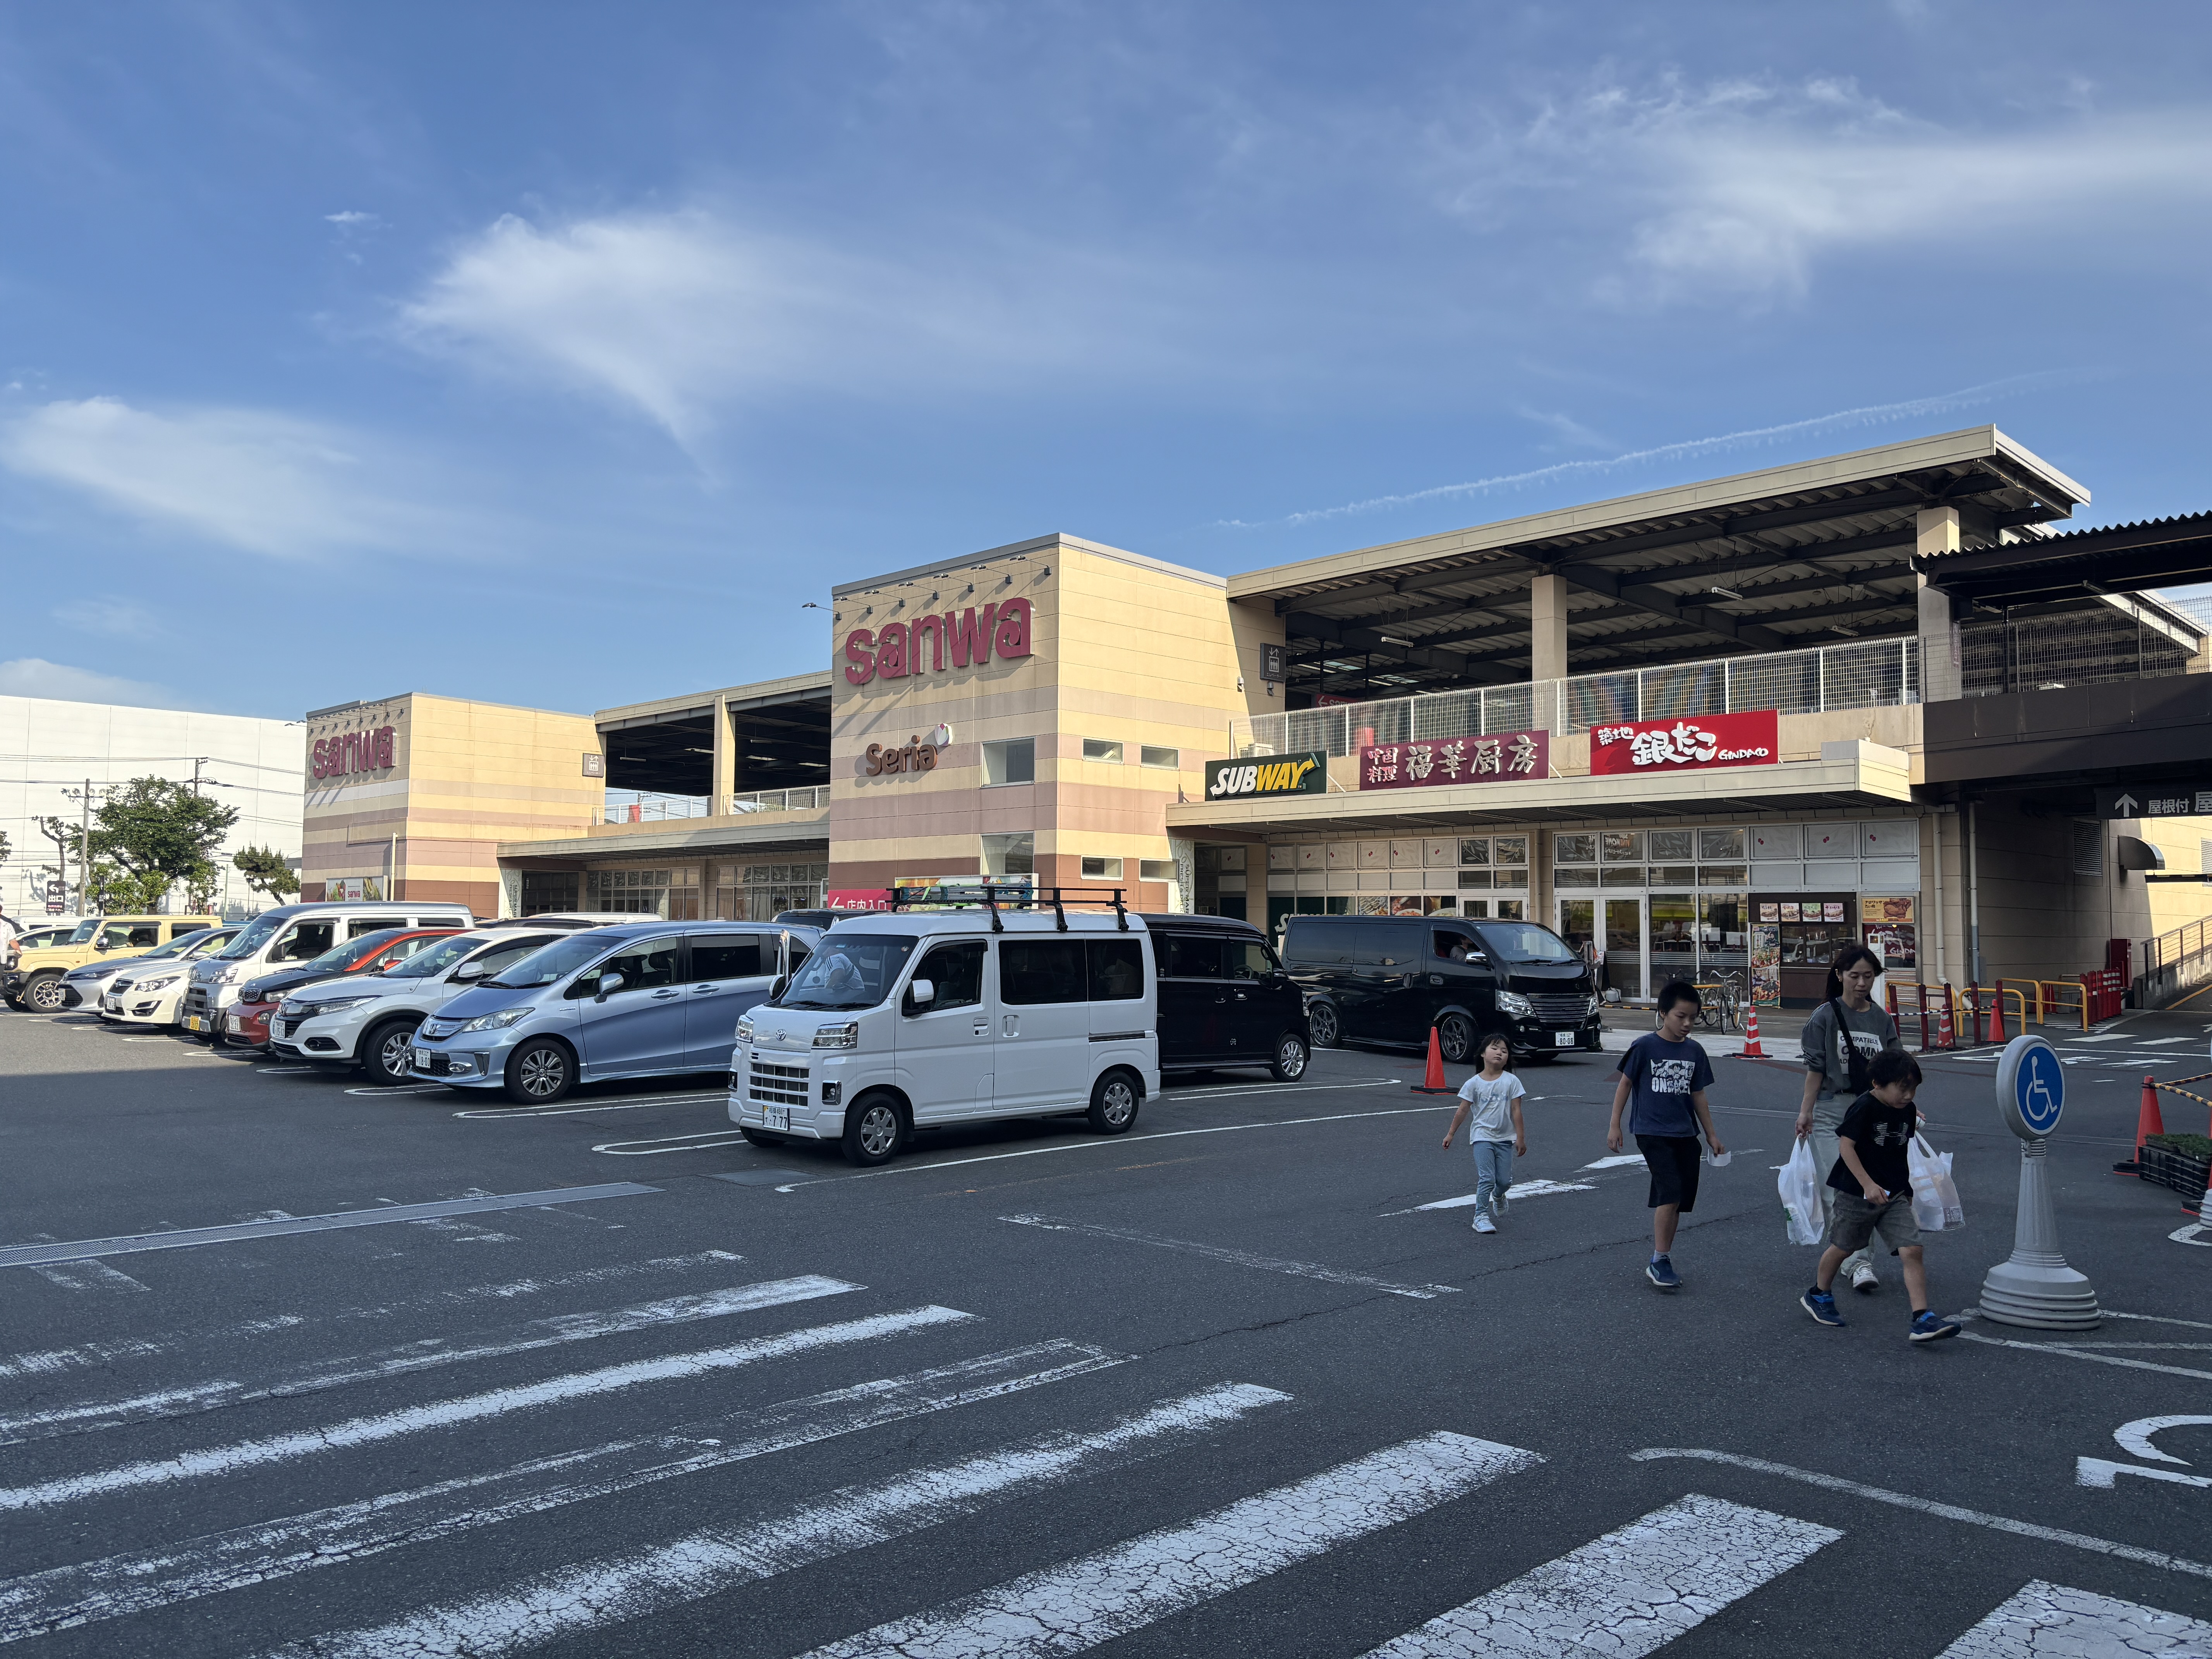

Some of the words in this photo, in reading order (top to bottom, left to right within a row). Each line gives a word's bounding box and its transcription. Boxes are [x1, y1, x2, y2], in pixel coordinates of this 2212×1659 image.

[845, 597, 1036, 685] sanwa
[313, 725, 396, 780] sanwa
[866, 735, 938, 776] Seria
[1597, 727, 1634, 746] 築地
[1630, 721, 1718, 765] 銀だこ
[1718, 747, 1769, 761] GINDACO
[1210, 757, 1315, 796] SUBWAY
[2148, 799, 2189, 814] 屋根付
[1840, 1036, 1879, 1045] CMPATIBLE
